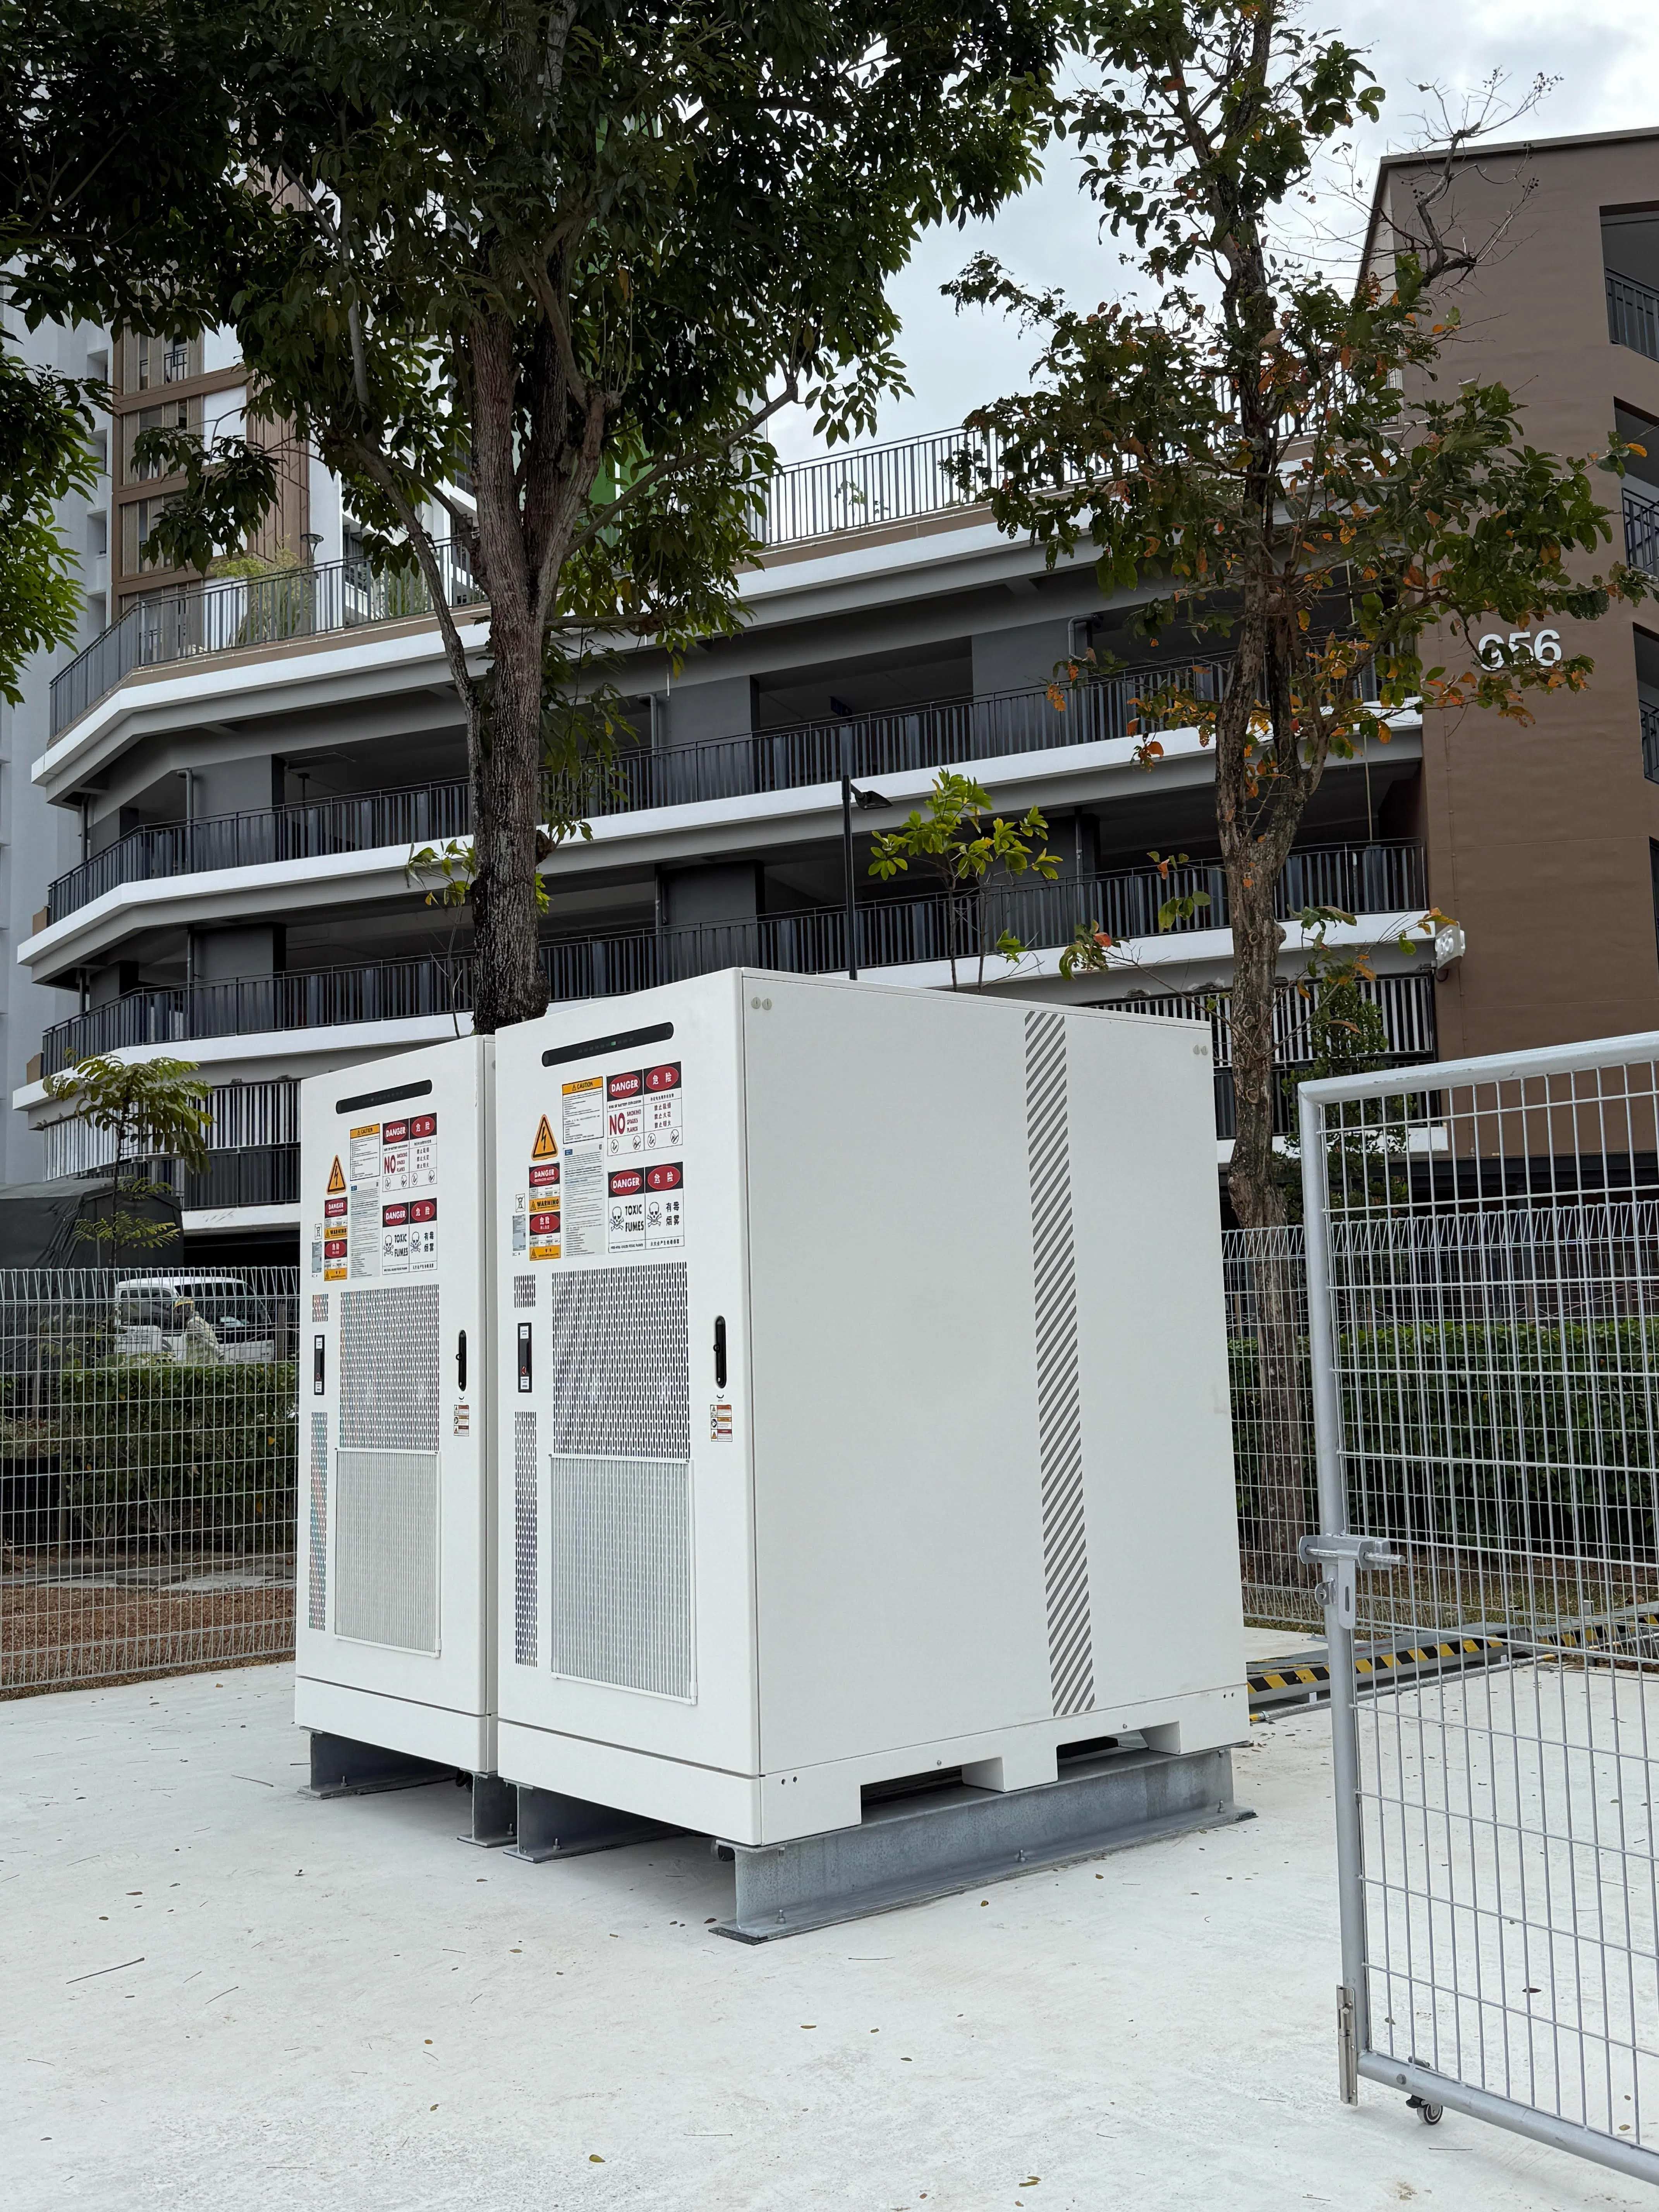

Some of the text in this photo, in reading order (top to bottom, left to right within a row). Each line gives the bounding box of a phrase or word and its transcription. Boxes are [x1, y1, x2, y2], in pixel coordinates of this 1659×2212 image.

[1478, 629, 1561, 671] 656
[611, 1079, 638, 1092] DANGER
[609, 1112, 625, 1135] NO
[386, 1126, 406, 1137] DANGER
[384, 1155, 396, 1174] NO
[534, 1169, 555, 1178] DANGER
[613, 1177, 639, 1189] DANGER
[386, 1210, 406, 1220] DANGER
[625, 1204, 642, 1216] TOXIC
[625, 1221, 644, 1232] FUMES
[394, 1233, 407, 1243] TOXIC
[394, 1247, 408, 1257] FUMES
